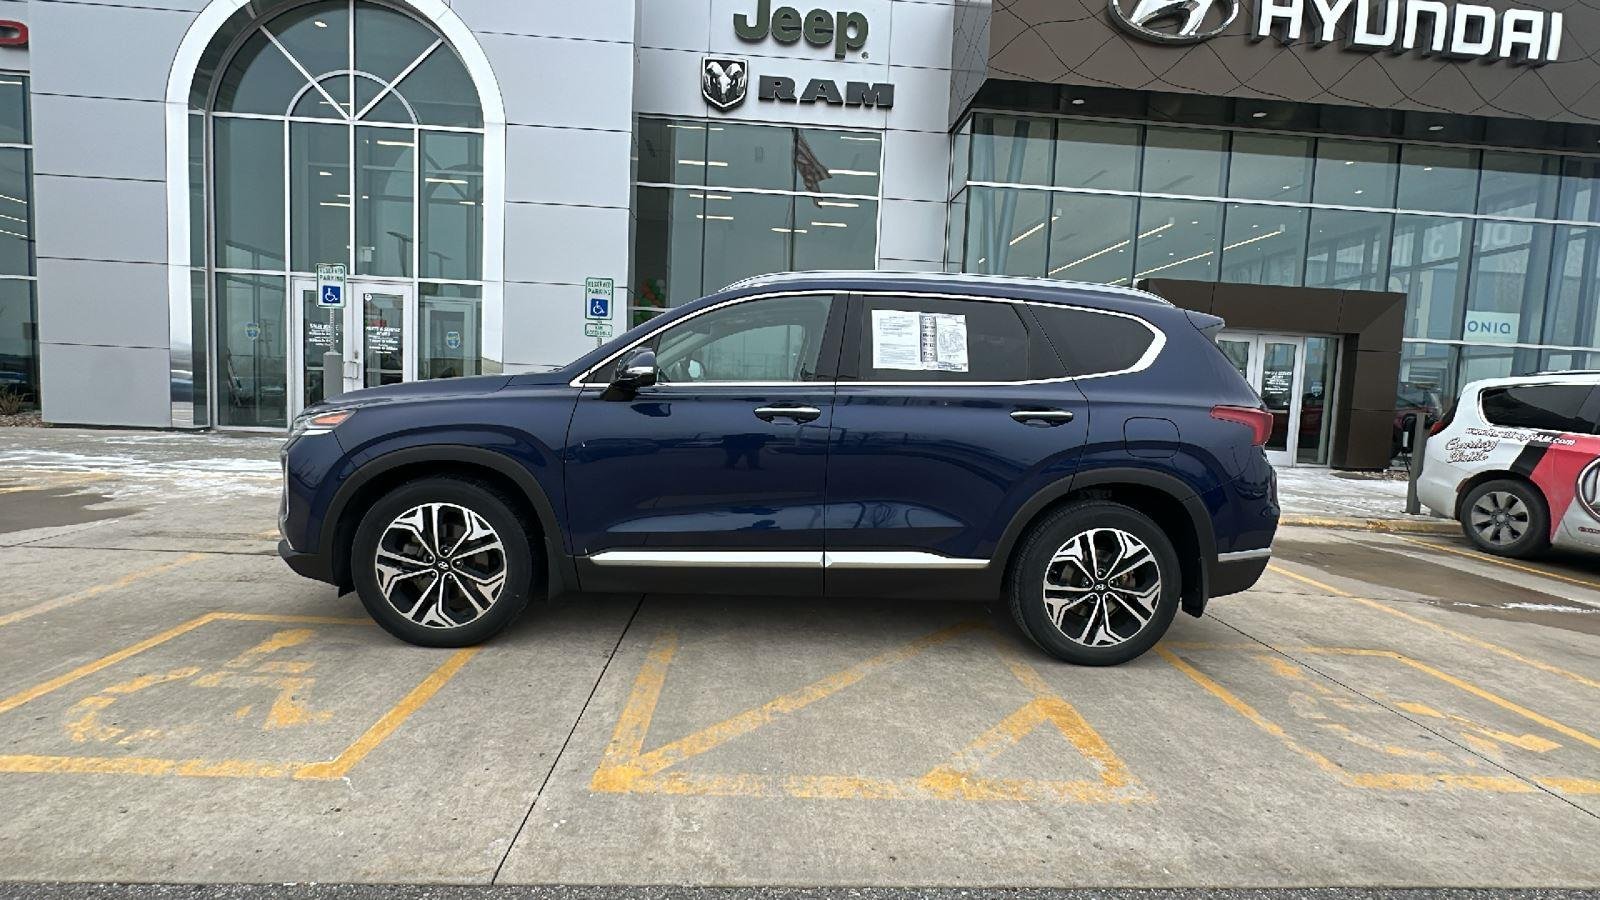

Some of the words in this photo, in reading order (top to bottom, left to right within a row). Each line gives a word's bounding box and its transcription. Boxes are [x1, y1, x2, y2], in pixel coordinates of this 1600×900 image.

[733, 0, 869, 59] Jeep
[1255, 0, 1563, 62] HYUNDAI
[758, 75, 894, 109] RAM
